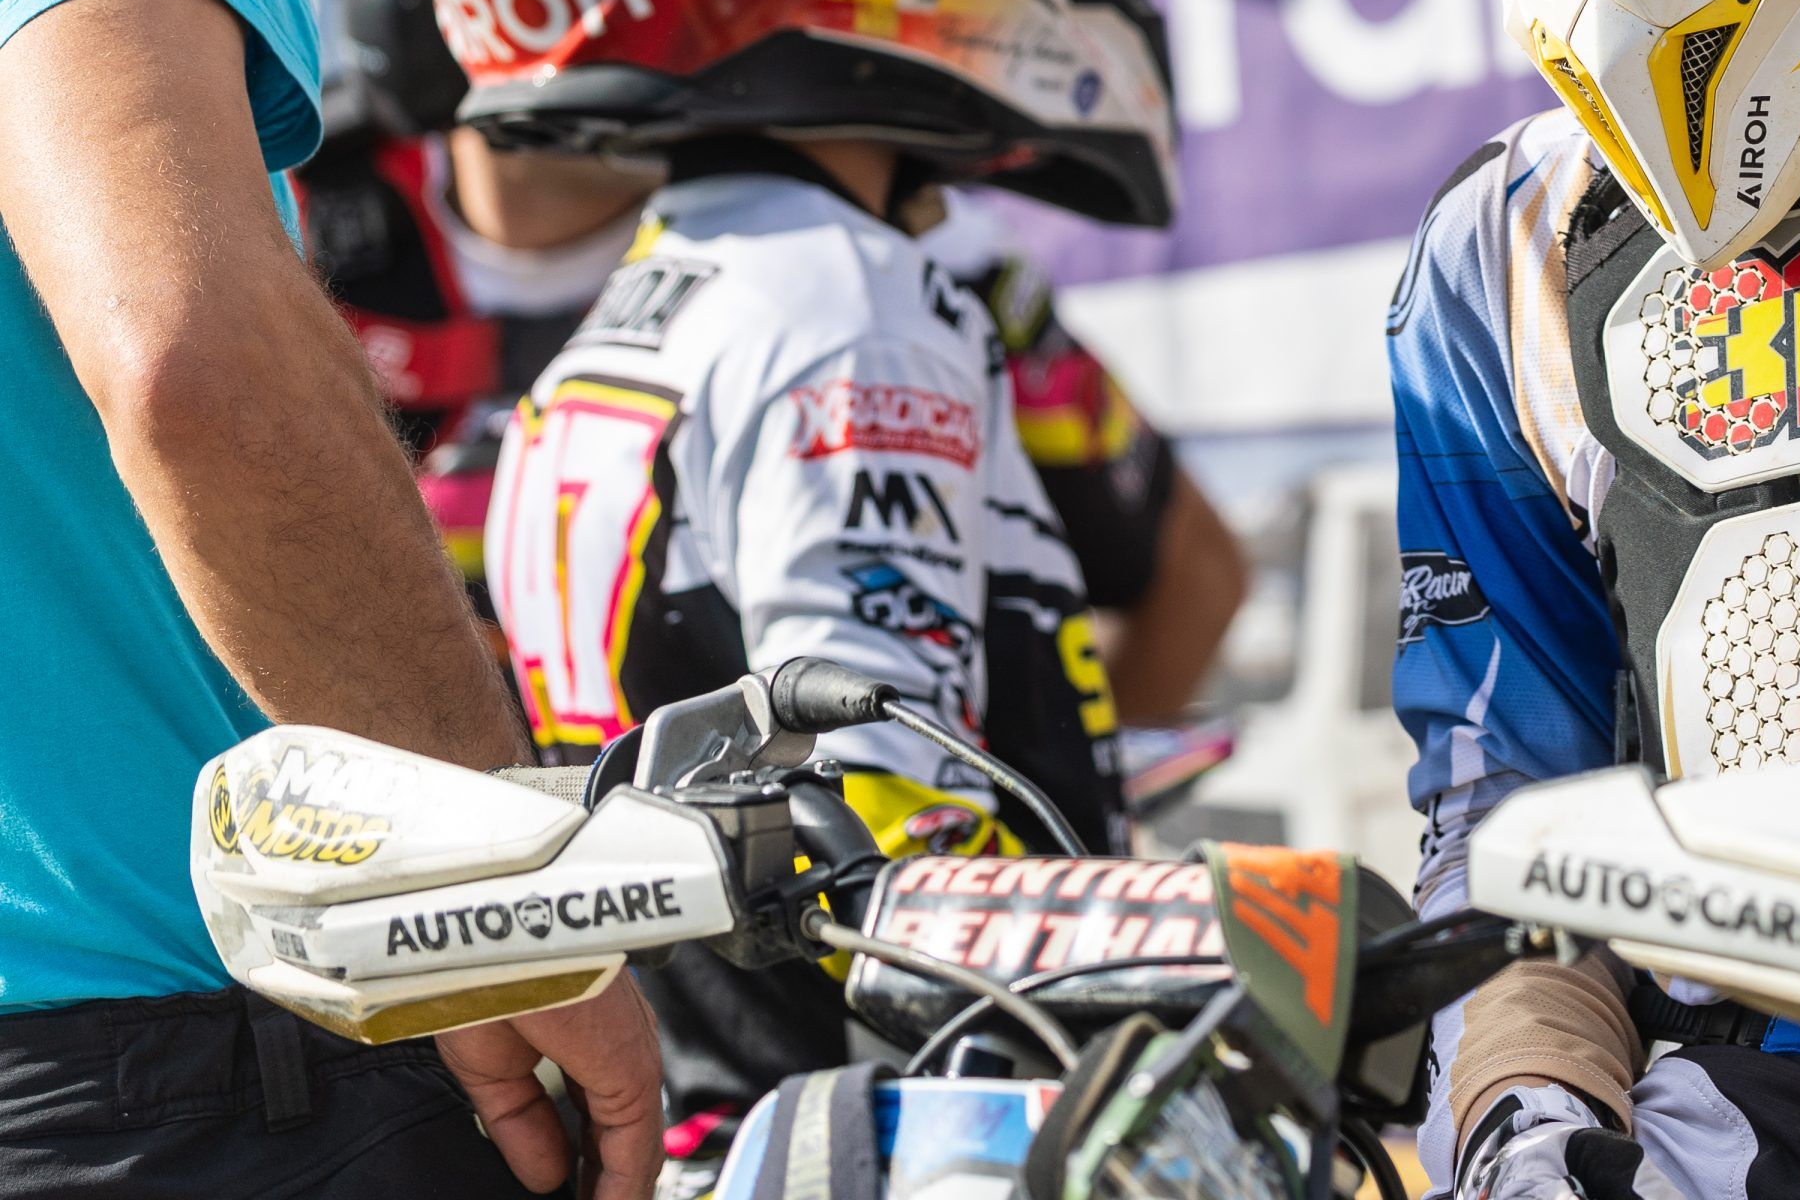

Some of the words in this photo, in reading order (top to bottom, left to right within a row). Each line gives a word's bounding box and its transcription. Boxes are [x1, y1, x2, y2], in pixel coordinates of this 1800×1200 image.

[1736, 94, 1771, 208] AIROH
[240, 799, 390, 866] MOTOS
[893, 855, 1214, 902] RENTHA
[1524, 848, 1655, 915] AUTO
[386, 907, 513, 957] AUTO
[558, 877, 683, 929] CARE
